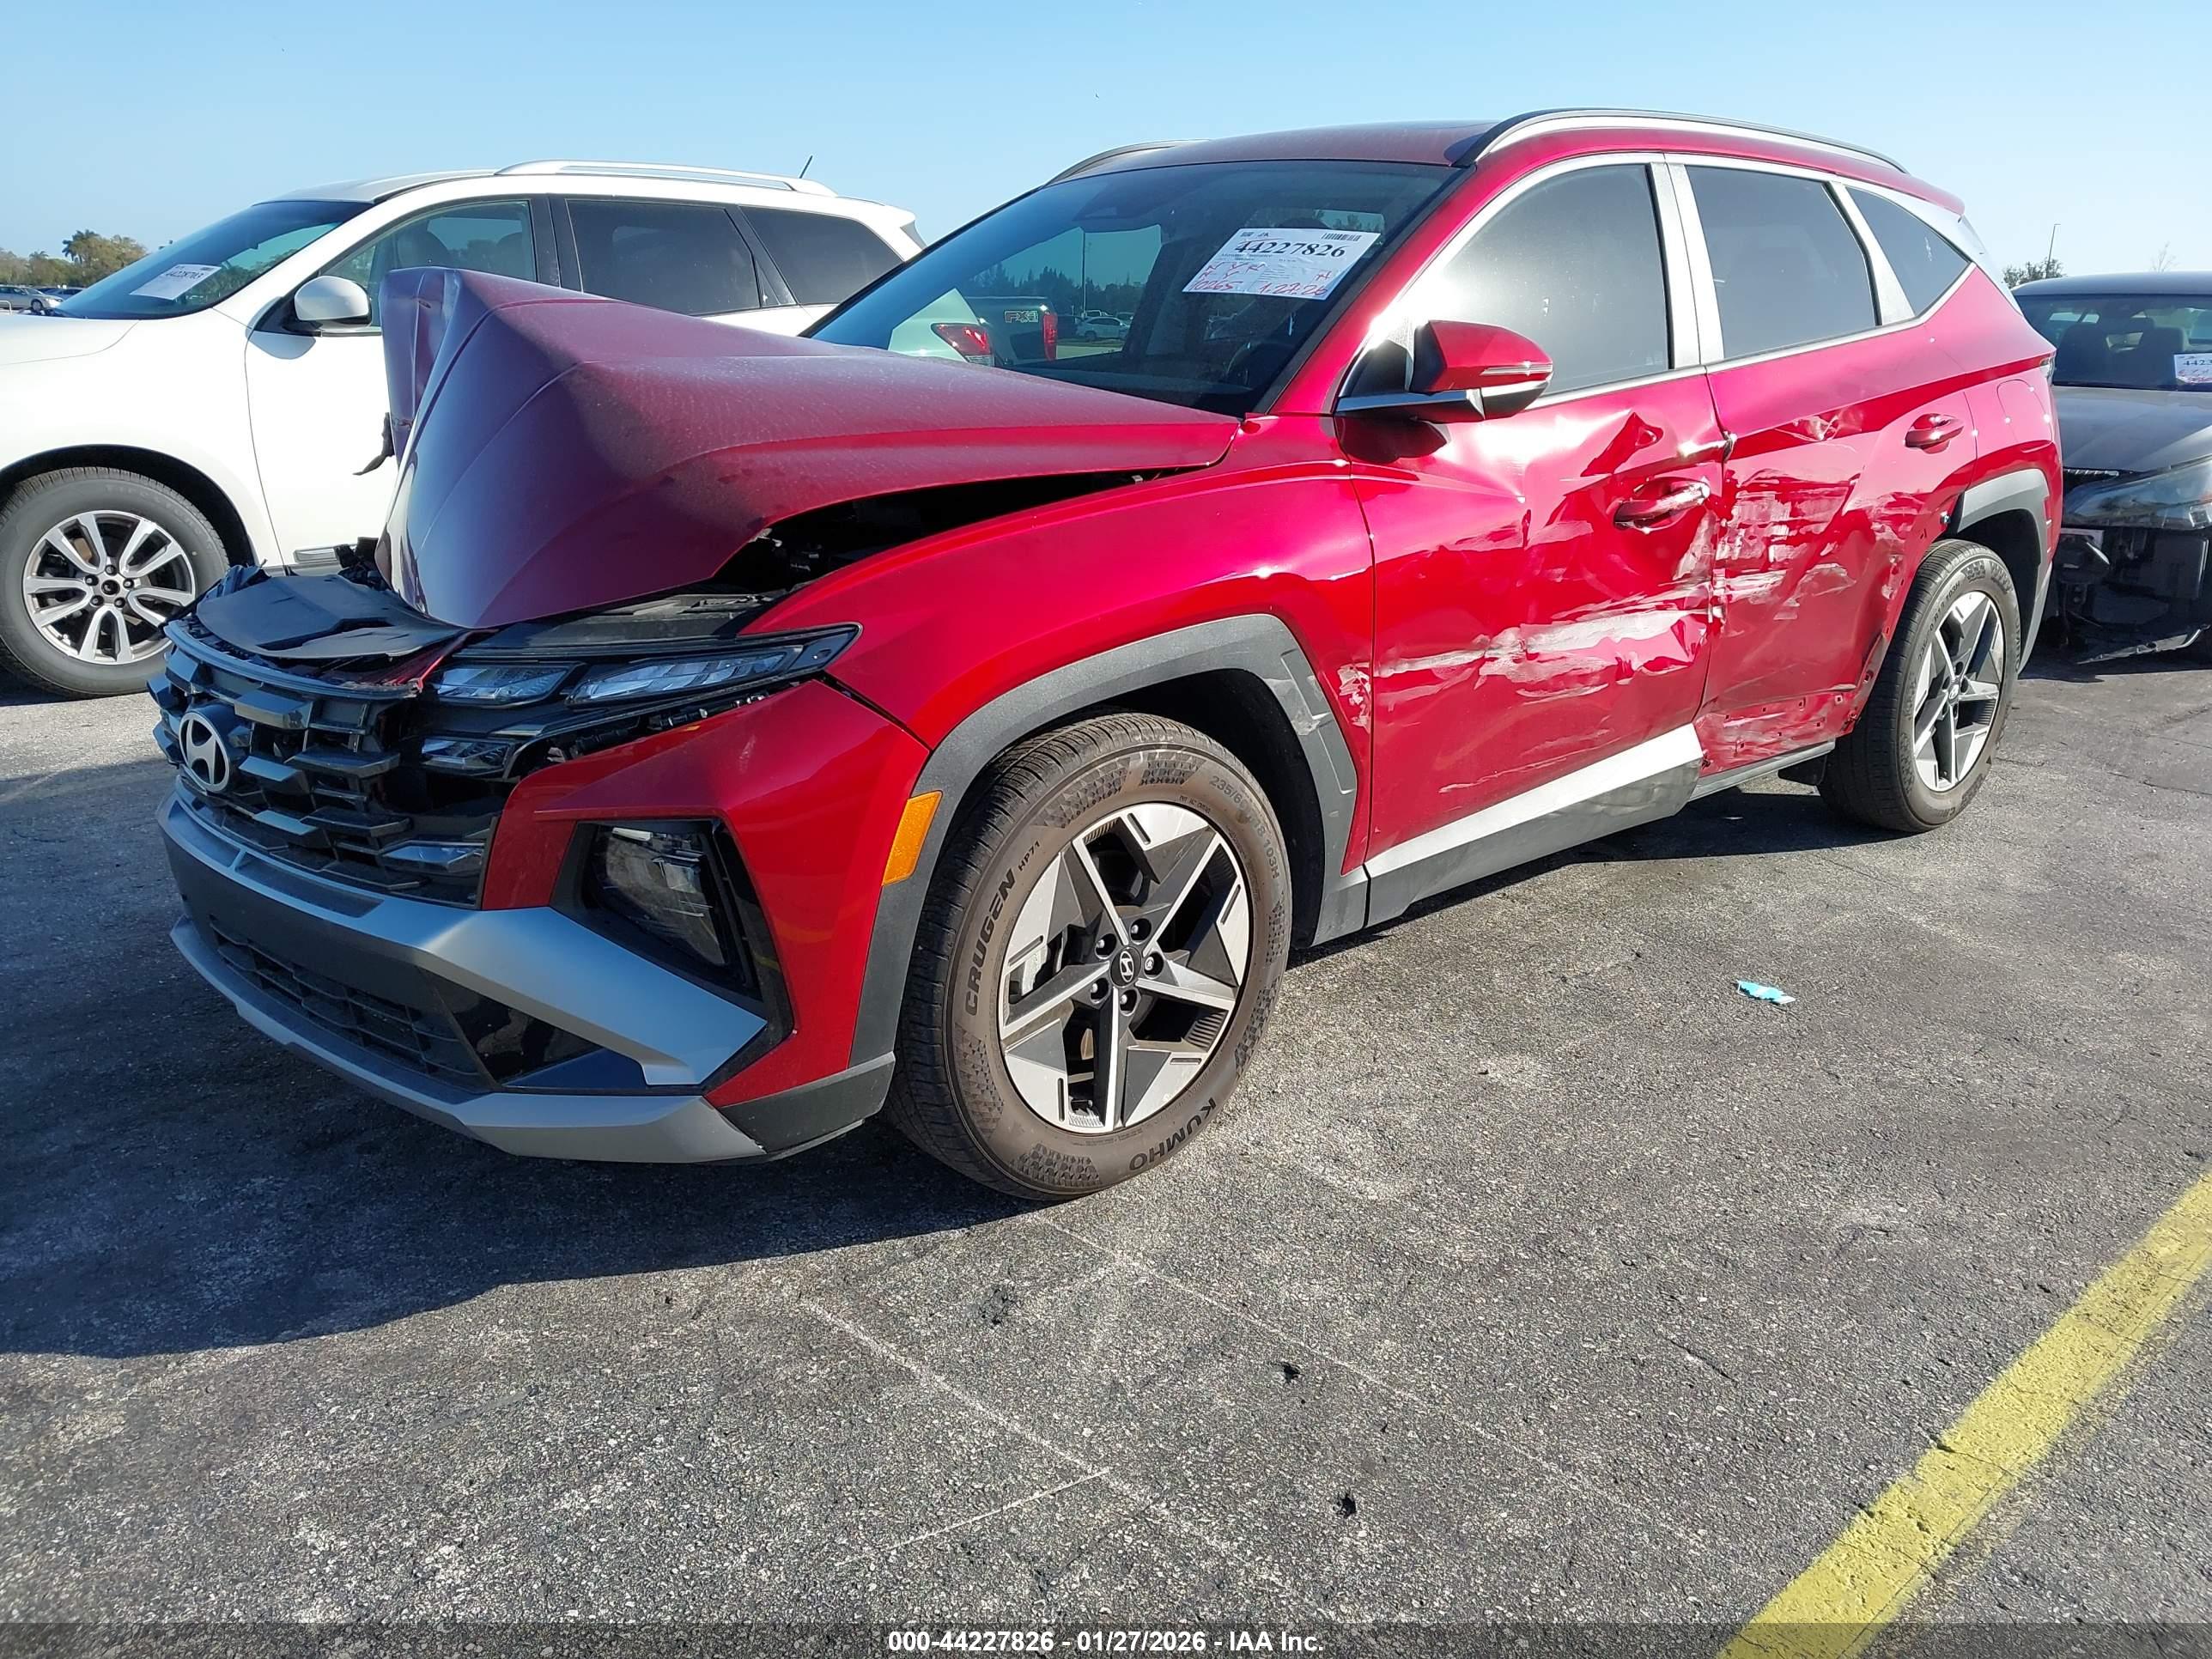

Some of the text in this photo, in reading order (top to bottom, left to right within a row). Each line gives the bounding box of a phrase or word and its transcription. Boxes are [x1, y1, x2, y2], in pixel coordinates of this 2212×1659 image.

[1235, 241, 1352, 258] 44227826
[1262, 838, 1280, 879] 103H
[965, 868, 1016, 1016] CRUGEN
[1018, 841, 1042, 872] HP71
[1129, 1097, 1217, 1171] KUMHO
